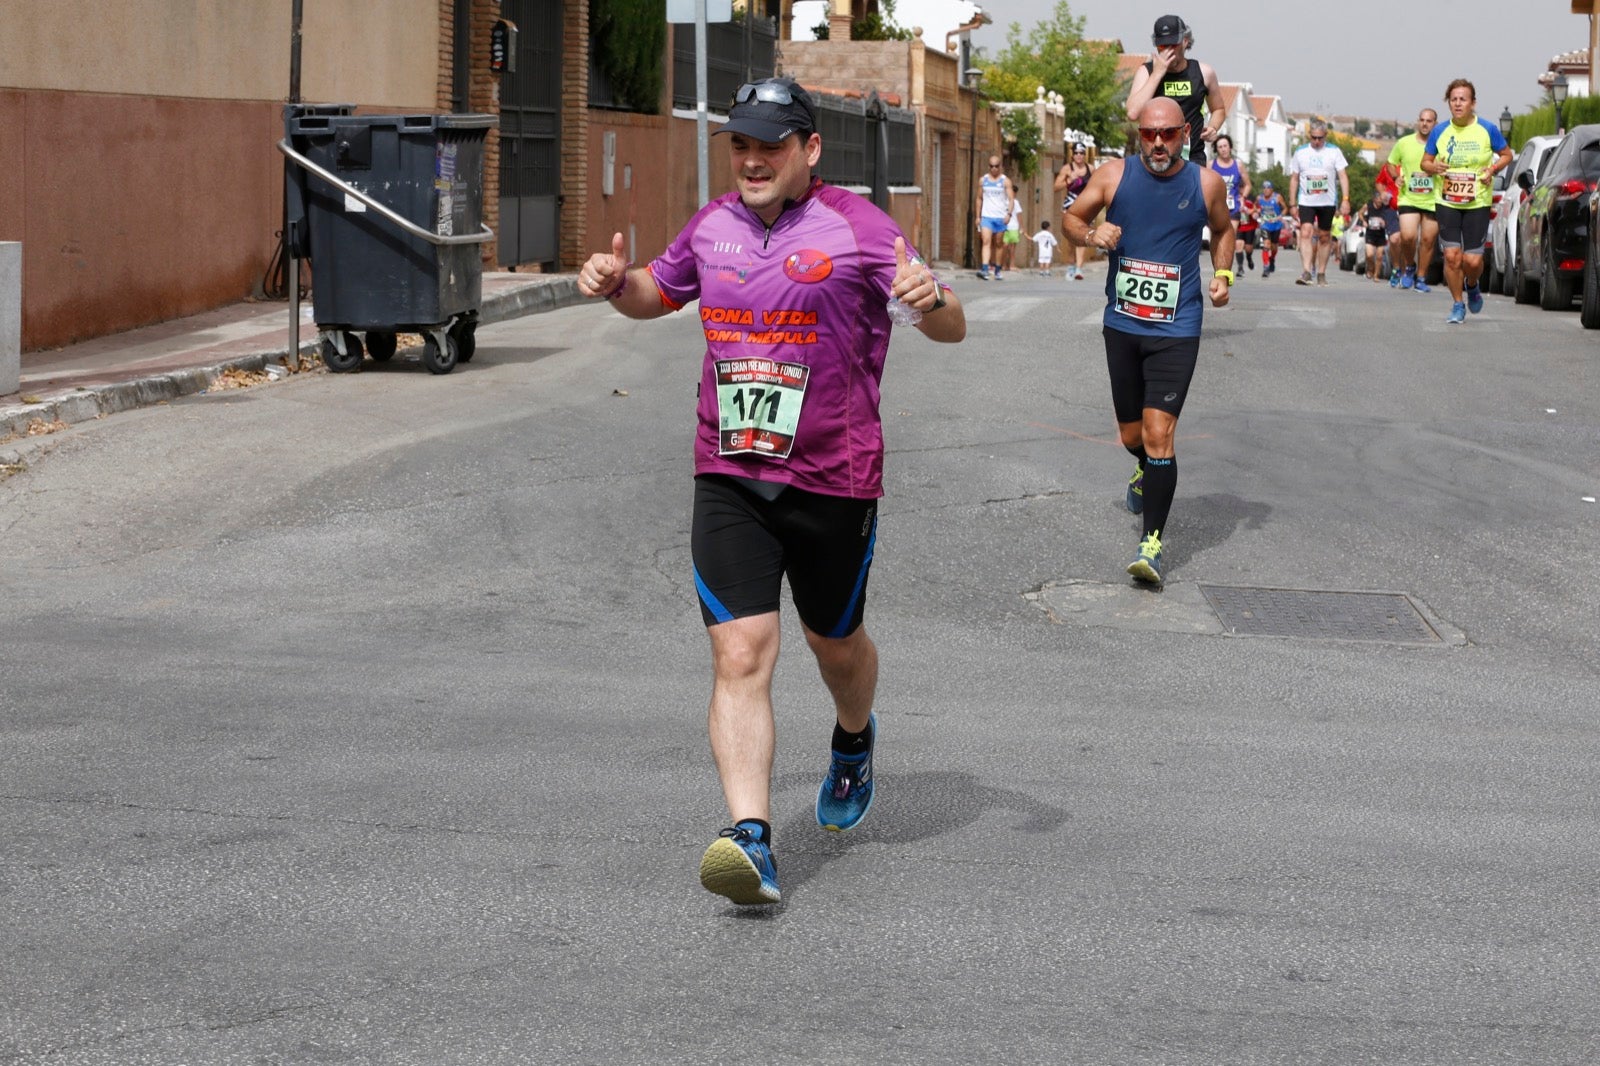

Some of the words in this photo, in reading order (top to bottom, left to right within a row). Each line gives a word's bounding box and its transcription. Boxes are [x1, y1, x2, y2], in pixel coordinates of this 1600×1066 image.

[1165, 83, 1189, 91] FILA
[1413, 179, 1430, 187] 360
[1447, 182, 1474, 194] 2072
[1125, 277, 1169, 303] 265
[701, 307, 754, 325] DONA
[762, 310, 818, 326] VIDA
[746, 327, 818, 344] MÉDULA
[731, 360, 748, 372] GRAN
[747, 361, 771, 372] PREMIO
[780, 365, 803, 379] FONDO
[732, 388, 782, 424] 171
